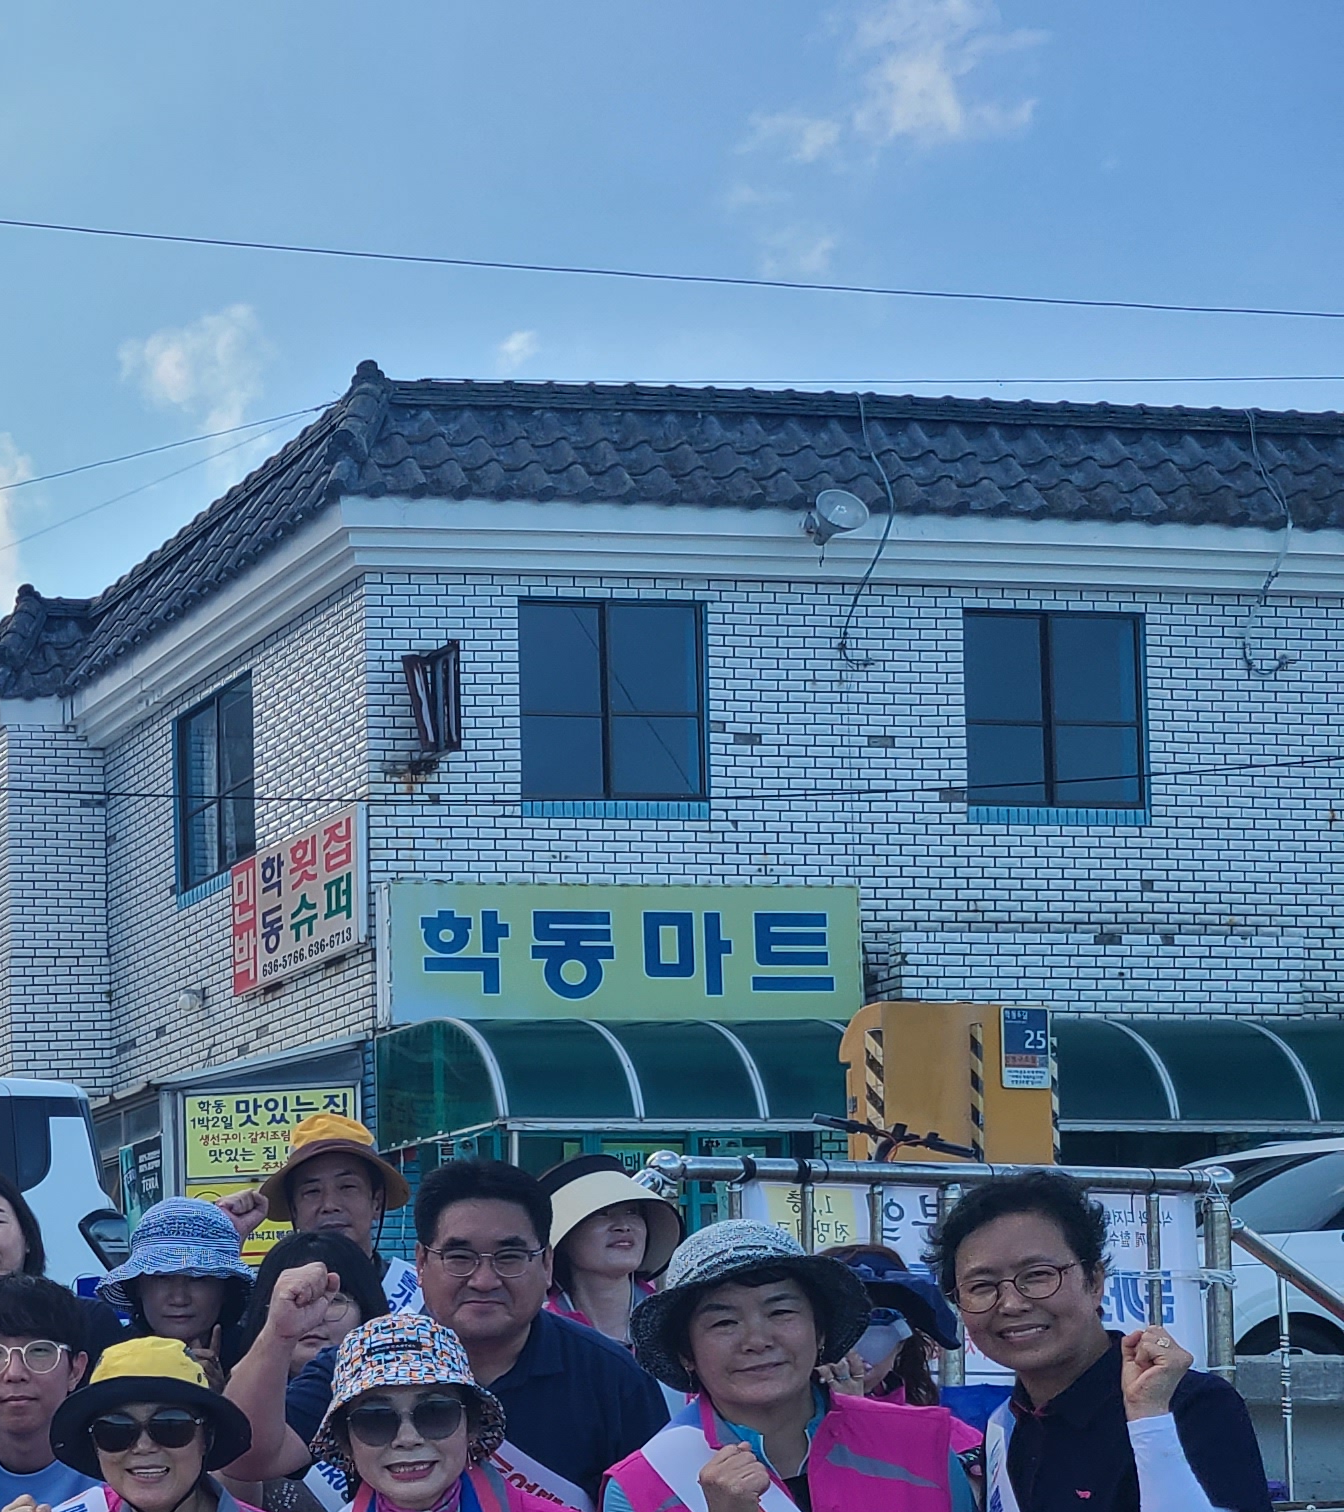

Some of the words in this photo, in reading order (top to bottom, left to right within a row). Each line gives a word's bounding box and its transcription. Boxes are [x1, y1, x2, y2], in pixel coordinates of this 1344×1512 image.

[289, 816, 352, 892] 횟집
[234, 866, 257, 981] 민박
[261, 852, 285, 954] 학동
[289, 871, 352, 943] 슈퍼
[420, 909, 836, 1000] 학동마트
[1024, 1029, 1046, 1049] 25
[190, 1115, 234, 1131] 1박2일
[198, 1100, 226, 1115] 학동
[208, 1147, 255, 1164] 맛있는
[262, 1146, 277, 1160] 집
